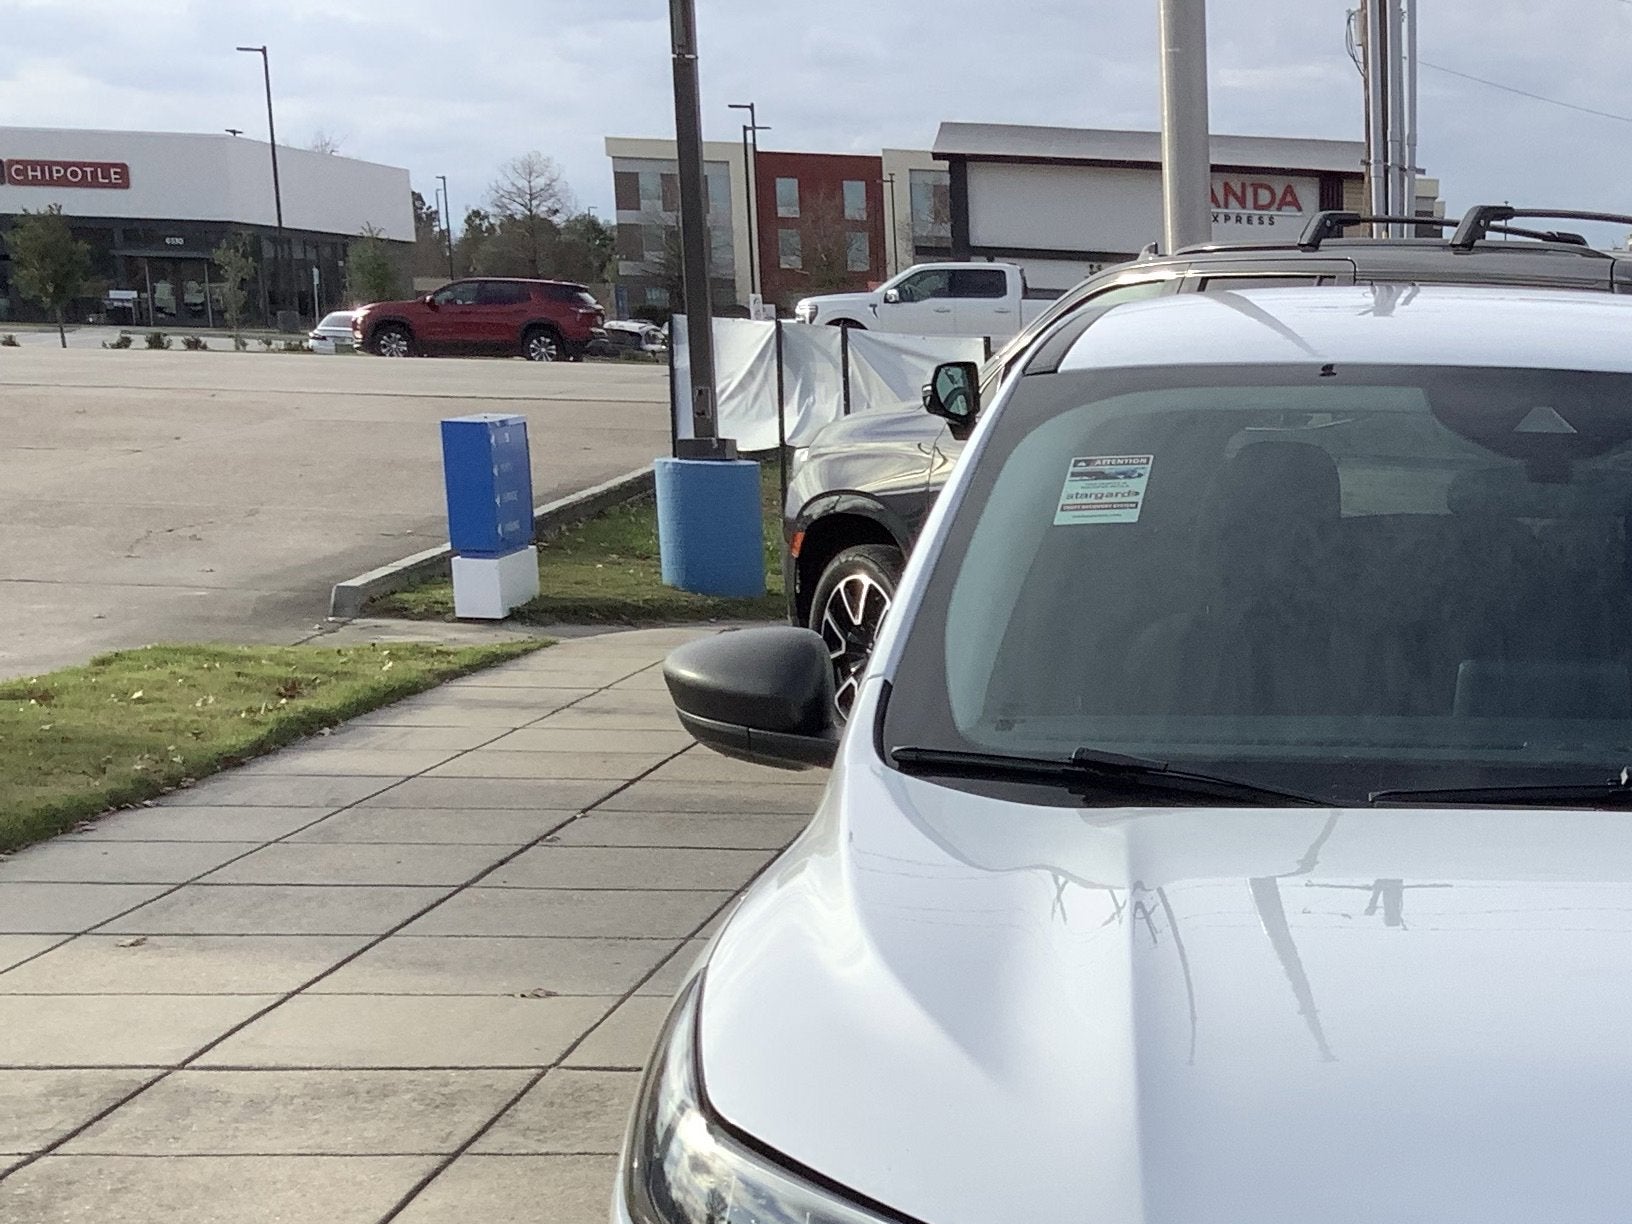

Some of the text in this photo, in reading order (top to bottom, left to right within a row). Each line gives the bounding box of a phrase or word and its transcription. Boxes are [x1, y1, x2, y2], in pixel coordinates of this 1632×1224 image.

[11, 164, 122, 183] CHIPOTLE
[1210, 181, 1303, 212] NDA
[1212, 214, 1275, 226] XPRESS
[1094, 458, 1147, 467] ATTENTION
